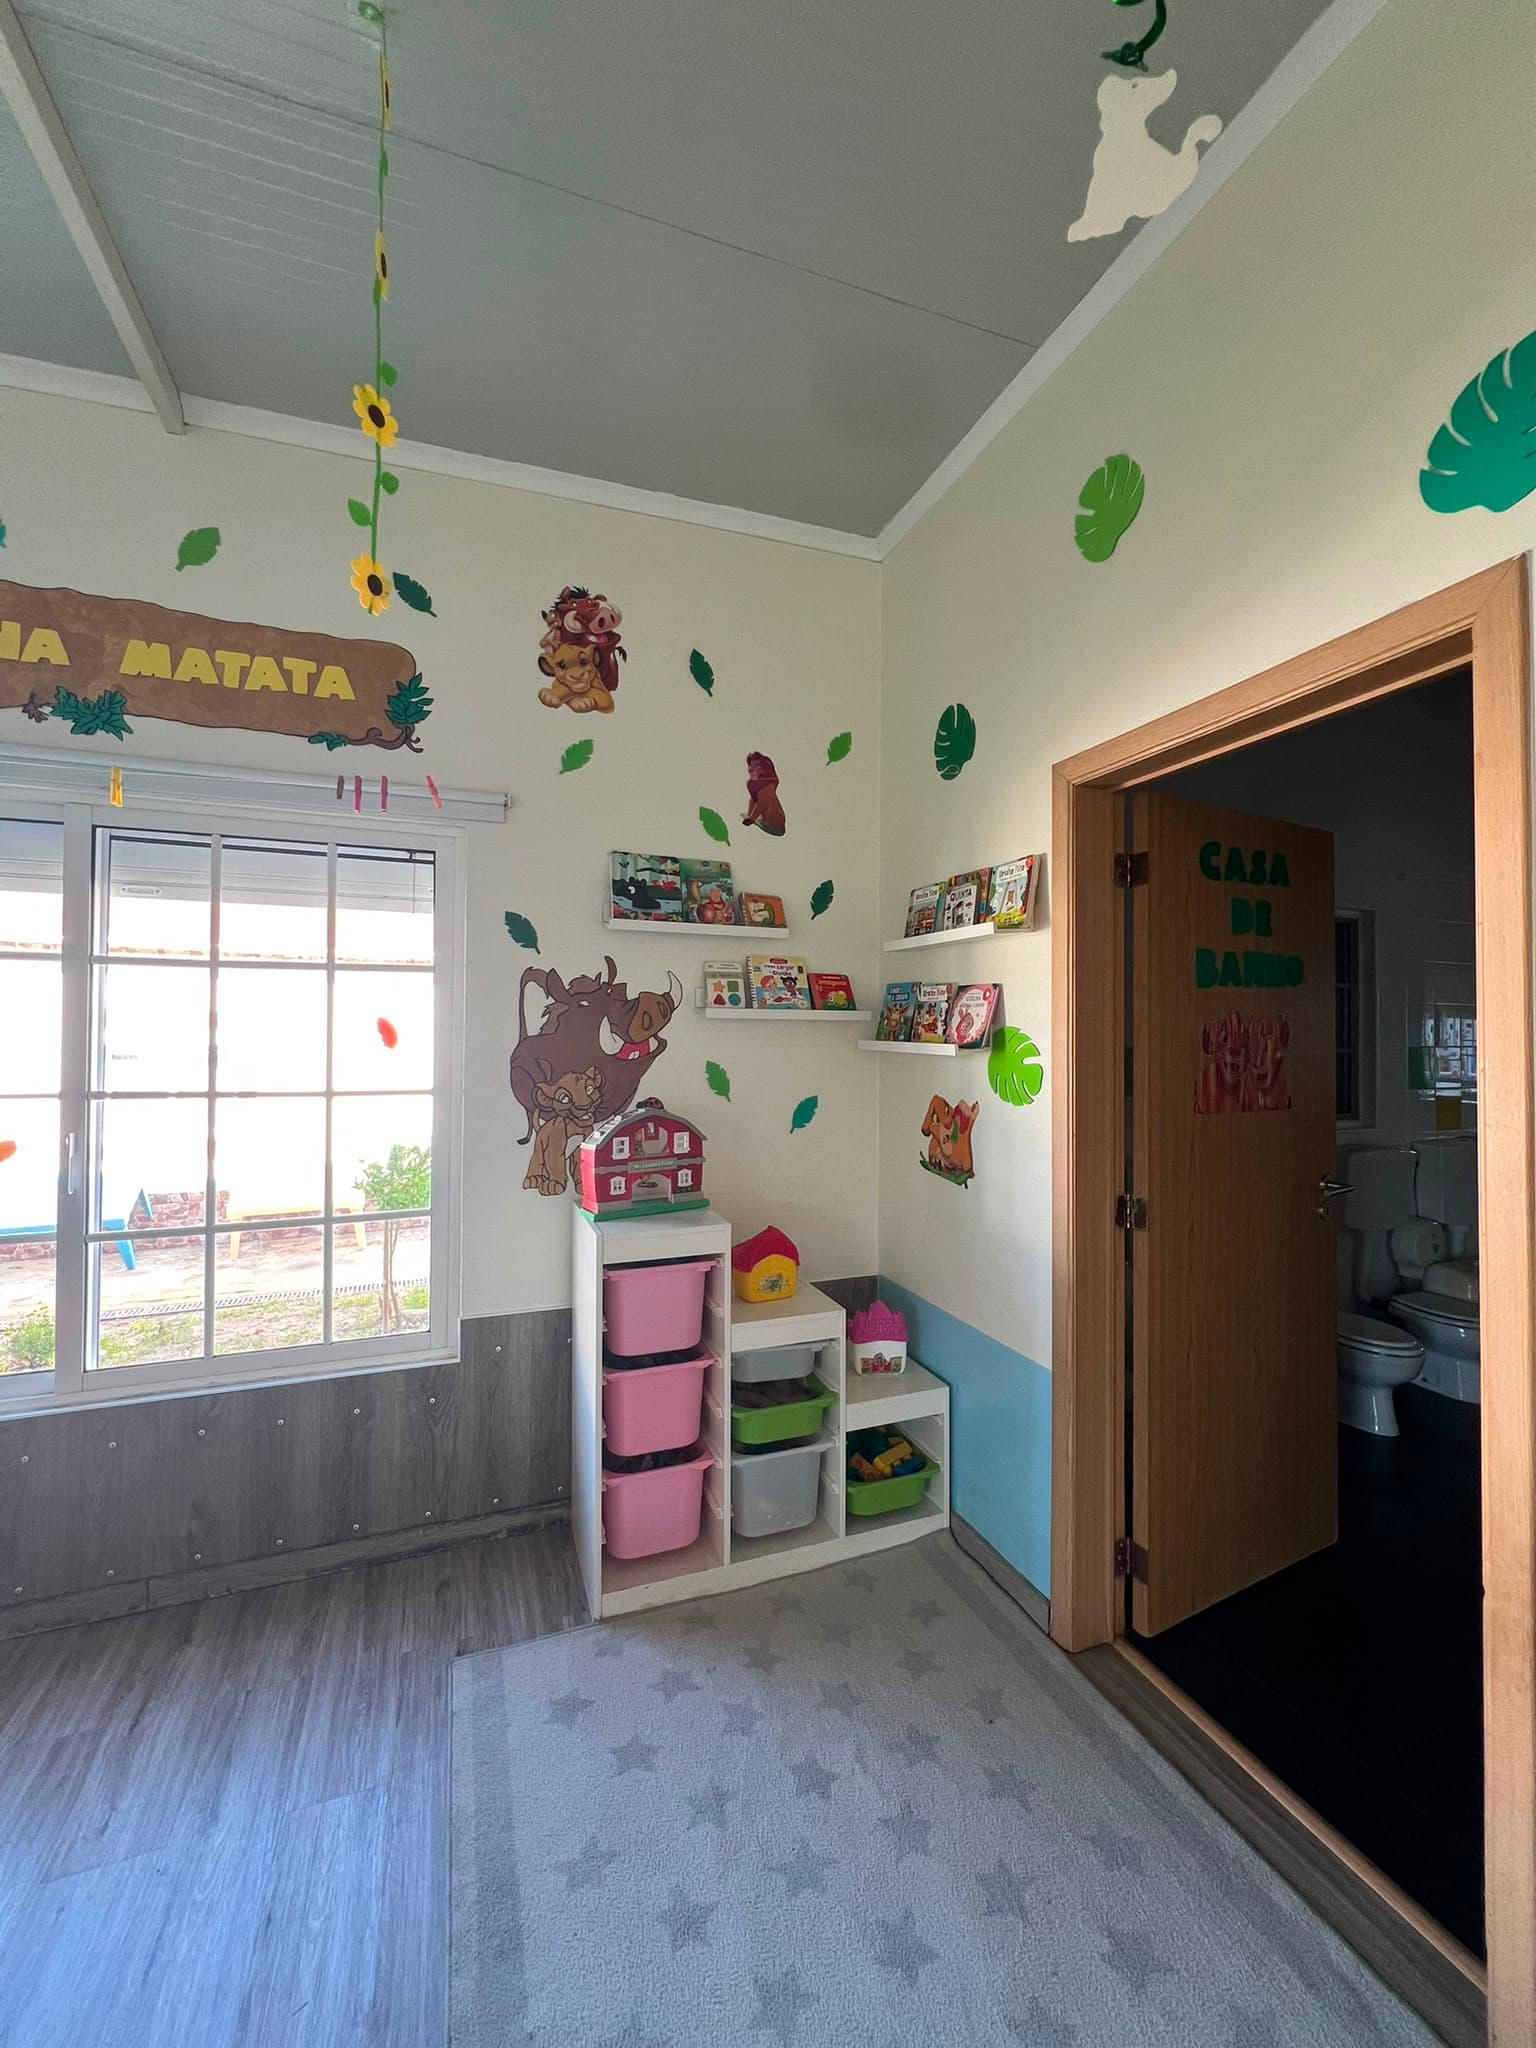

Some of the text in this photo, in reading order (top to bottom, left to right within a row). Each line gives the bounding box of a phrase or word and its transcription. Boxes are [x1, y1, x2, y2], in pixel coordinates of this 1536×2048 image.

[119, 639, 357, 701] MATATA
[1199, 840, 1290, 887] CASA
[1231, 897, 1273, 938] DE
